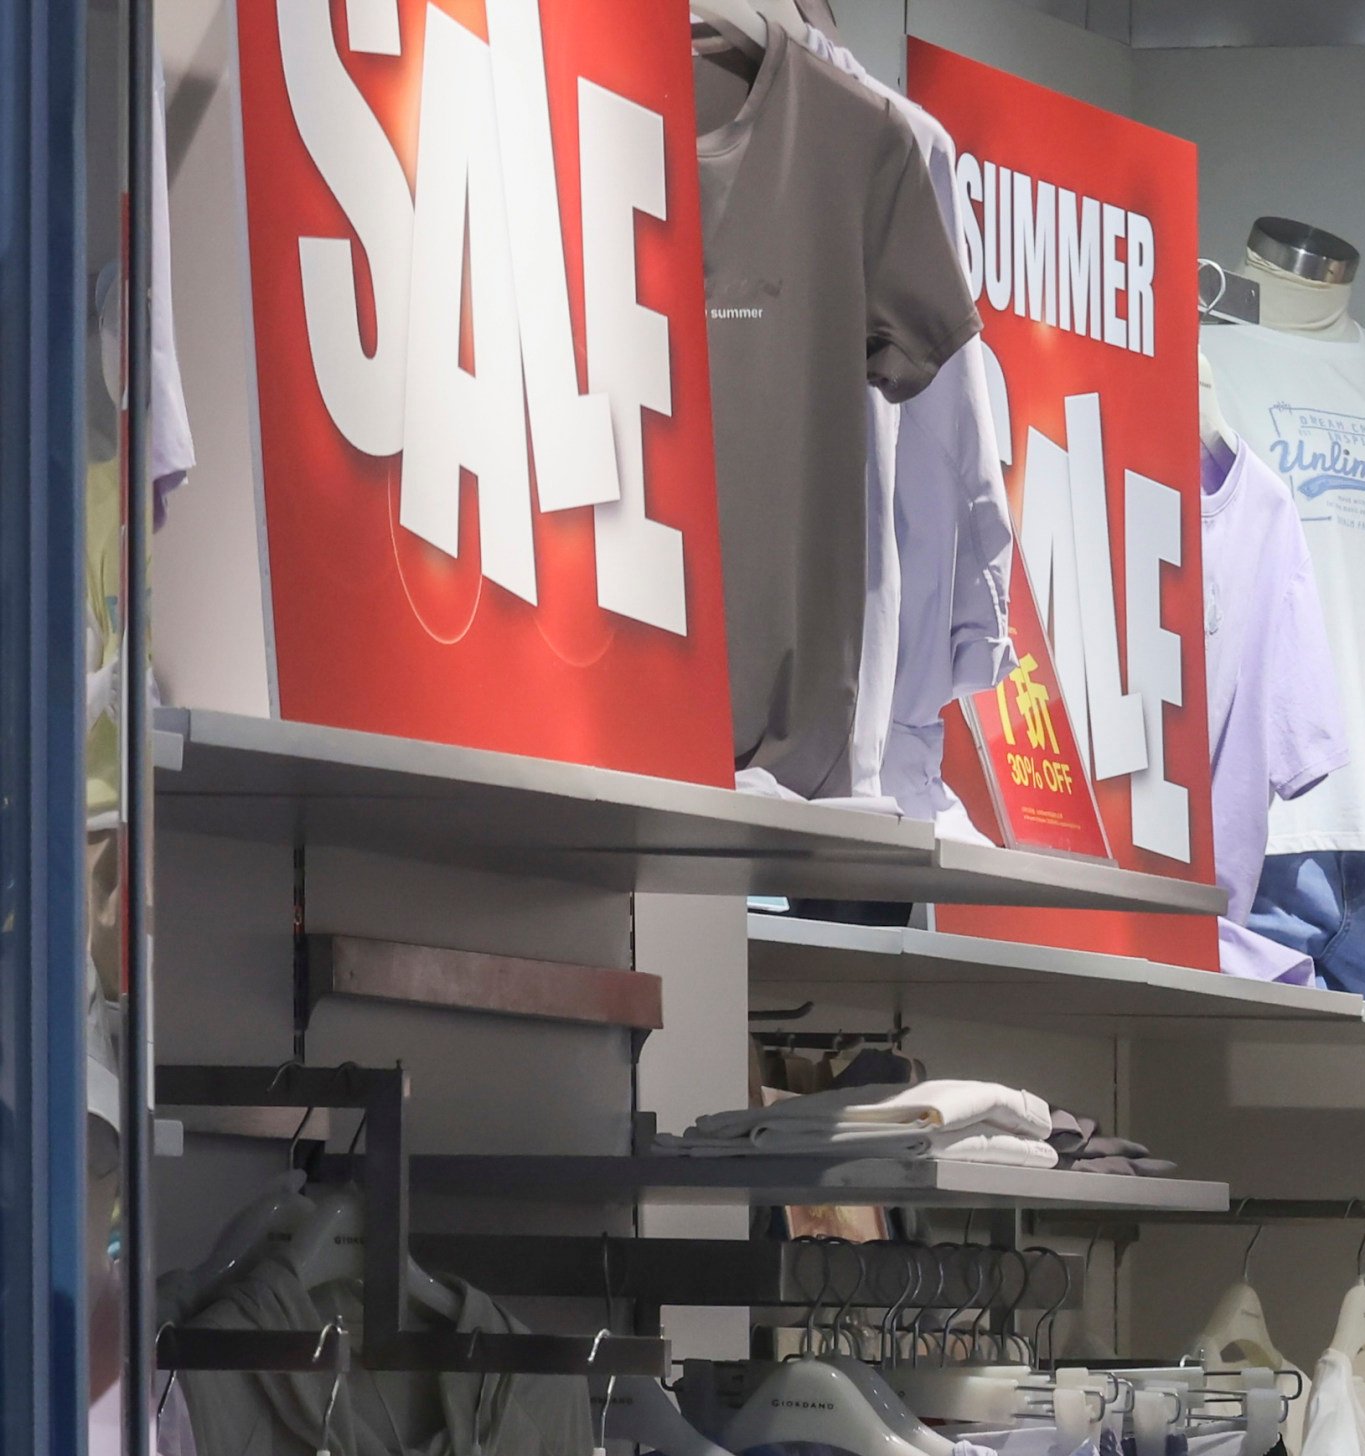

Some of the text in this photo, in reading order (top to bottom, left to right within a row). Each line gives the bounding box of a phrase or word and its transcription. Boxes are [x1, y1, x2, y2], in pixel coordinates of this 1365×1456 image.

[710, 307, 763, 319] summer
[957, 152, 1156, 357] SUMMER
[276, 0, 688, 637] SALE
[980, 341, 1191, 864] ALE
[1007, 753, 1073, 795] 30% OFF
[771, 1399, 834, 1411] GIORDANO
